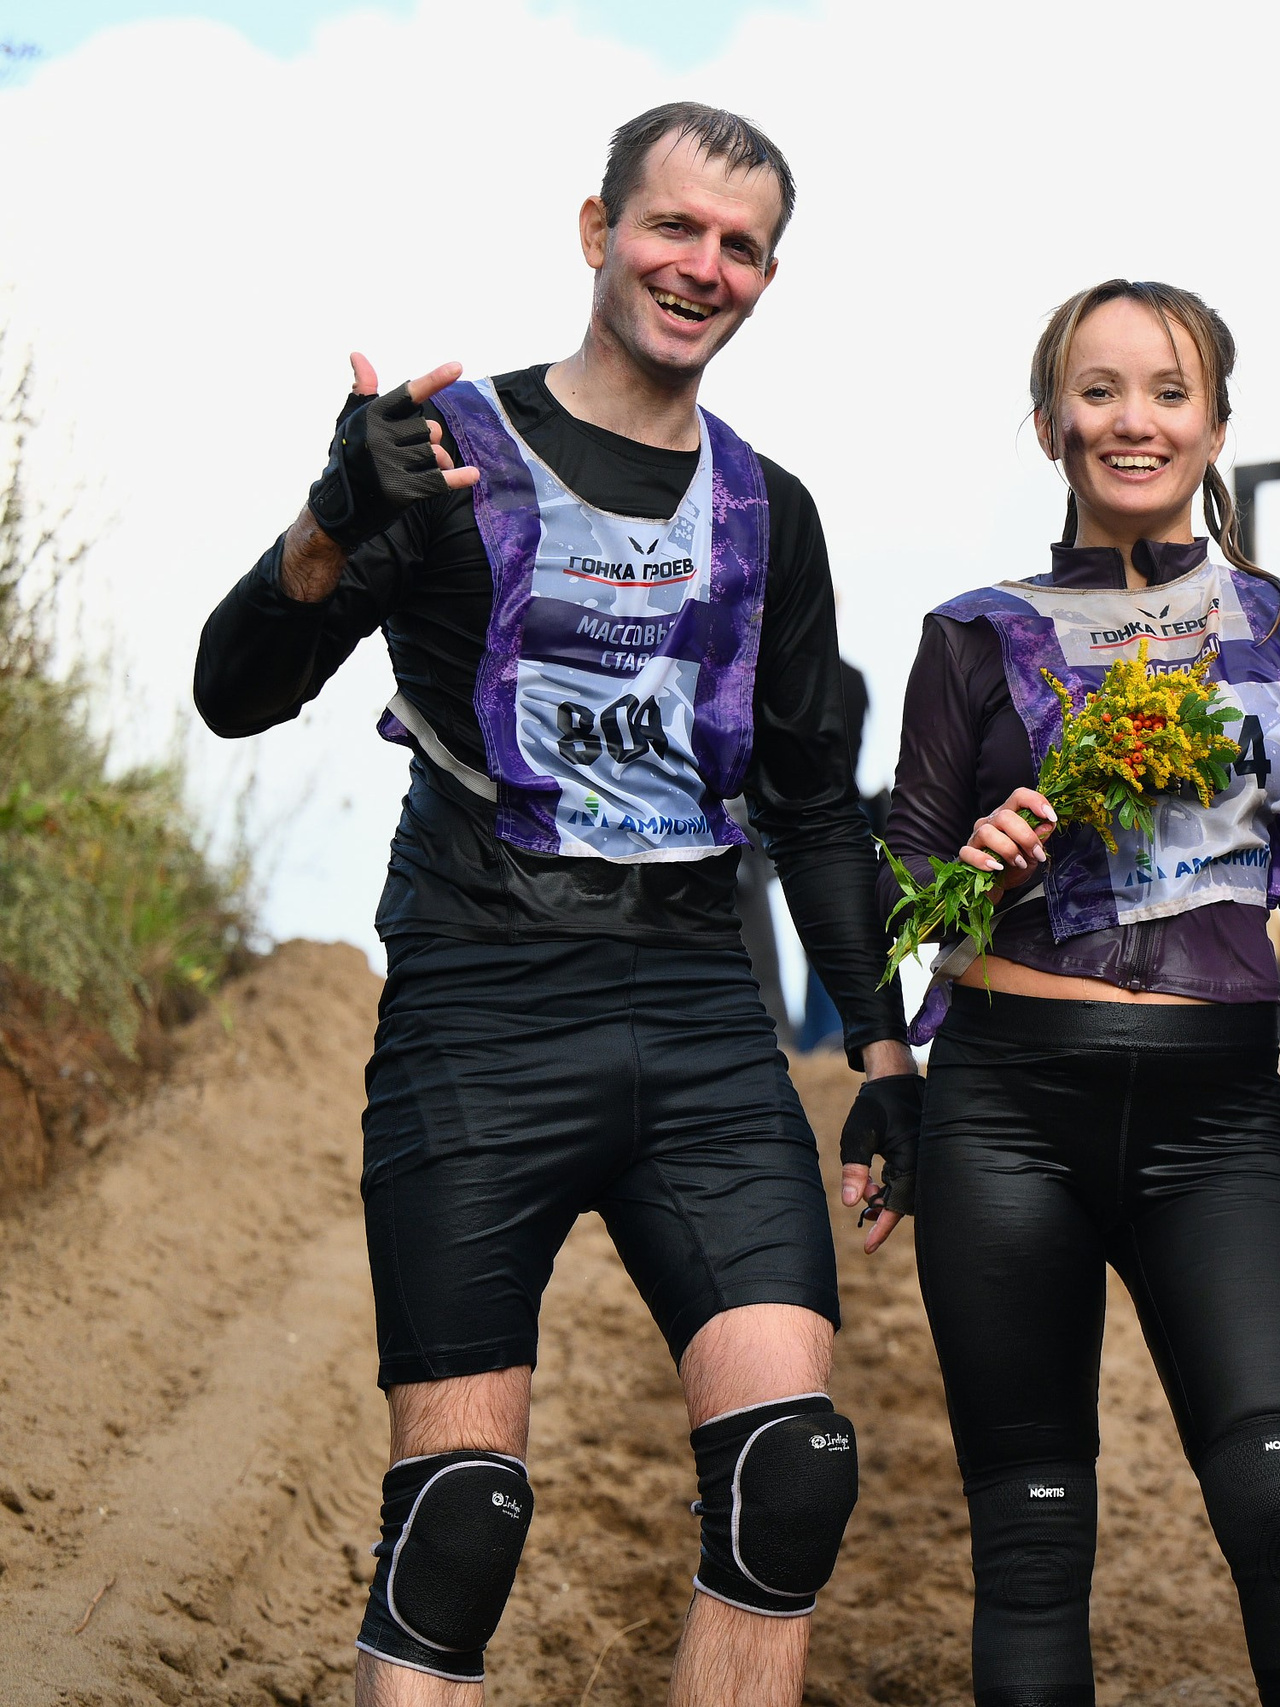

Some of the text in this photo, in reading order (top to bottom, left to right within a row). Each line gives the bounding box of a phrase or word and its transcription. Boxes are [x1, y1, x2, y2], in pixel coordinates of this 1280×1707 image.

[569, 556, 636, 580] ГОНКА
[1089, 621, 1158, 645] ГОНКА
[600, 650, 654, 672] СТАР
[1029, 1486, 1065, 1498] NORTIS
